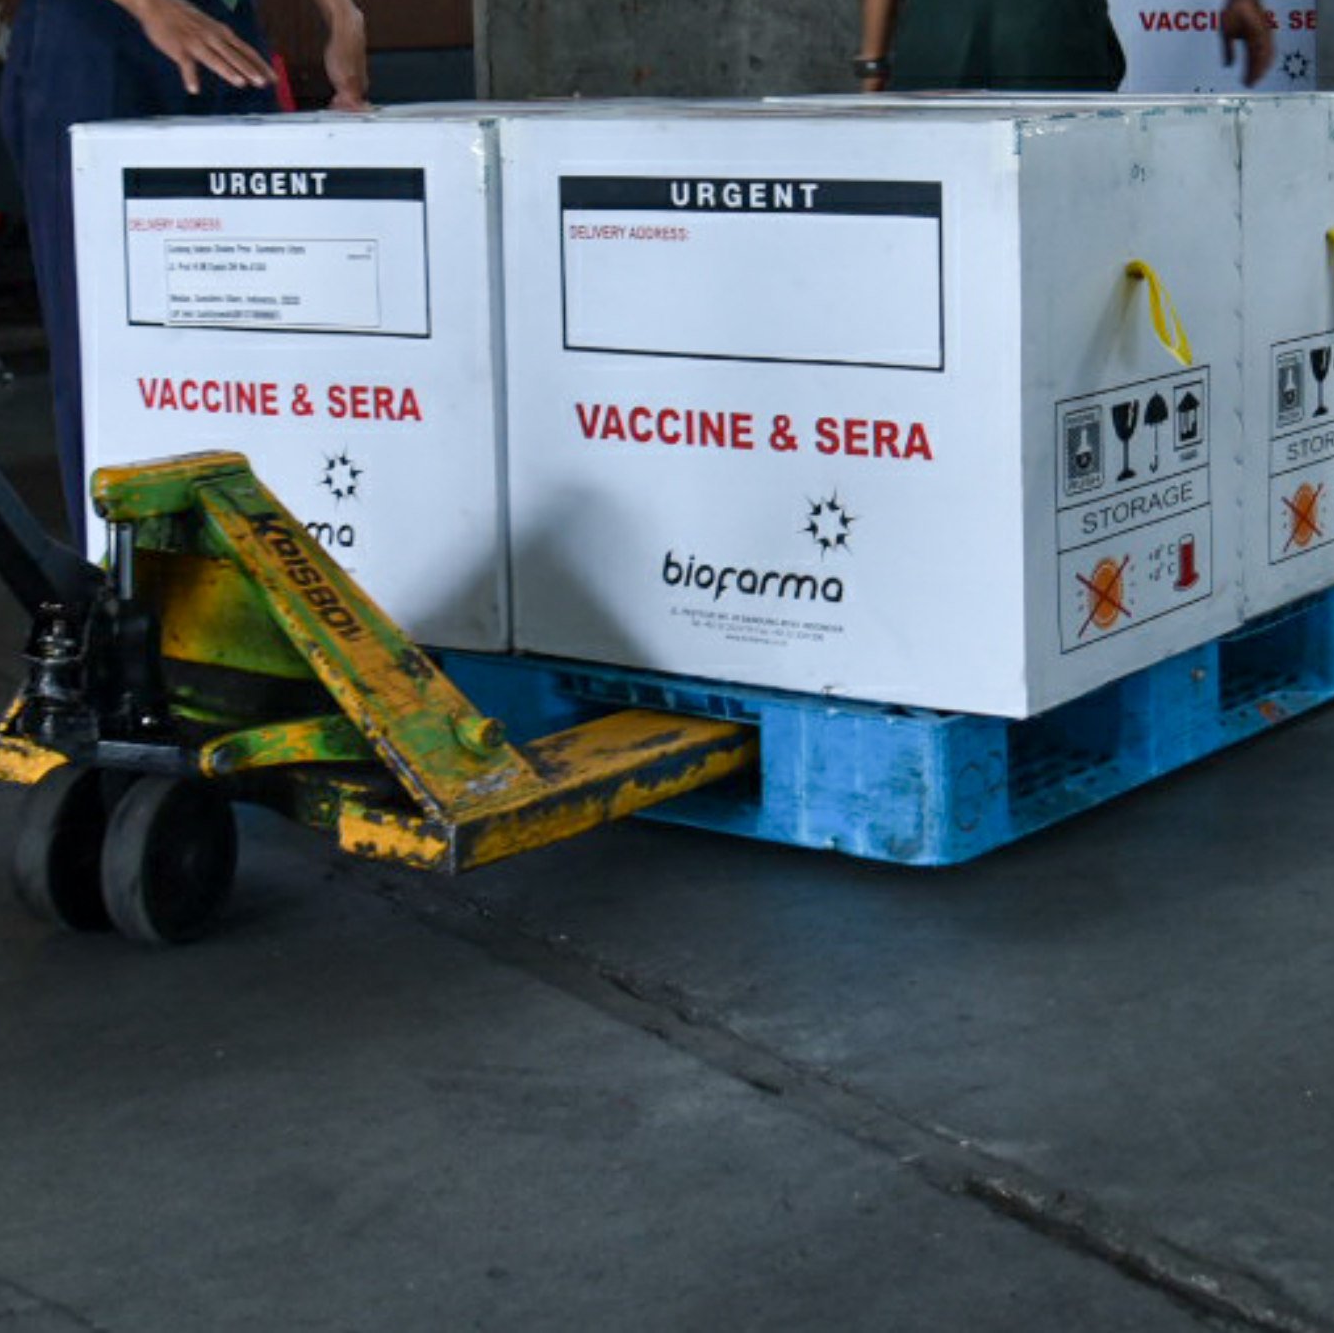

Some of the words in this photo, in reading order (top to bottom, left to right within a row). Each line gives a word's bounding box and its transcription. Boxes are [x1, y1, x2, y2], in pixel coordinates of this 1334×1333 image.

[1139, 9, 1218, 32] VACCI
[1288, 9, 1318, 31] SE
[209, 172, 328, 197] URGENT
[671, 182, 820, 209] URGENT
[569, 225, 624, 240] DELIVERY
[137, 377, 280, 416] VACCINE
[291, 383, 315, 416] &
[327, 385, 423, 421] SERA
[576, 403, 754, 451] VACCINE
[769, 414, 798, 452] &
[815, 418, 934, 461] SERA
[1081, 481, 1194, 535] STORAGE
[662, 550, 844, 603] biofarma
